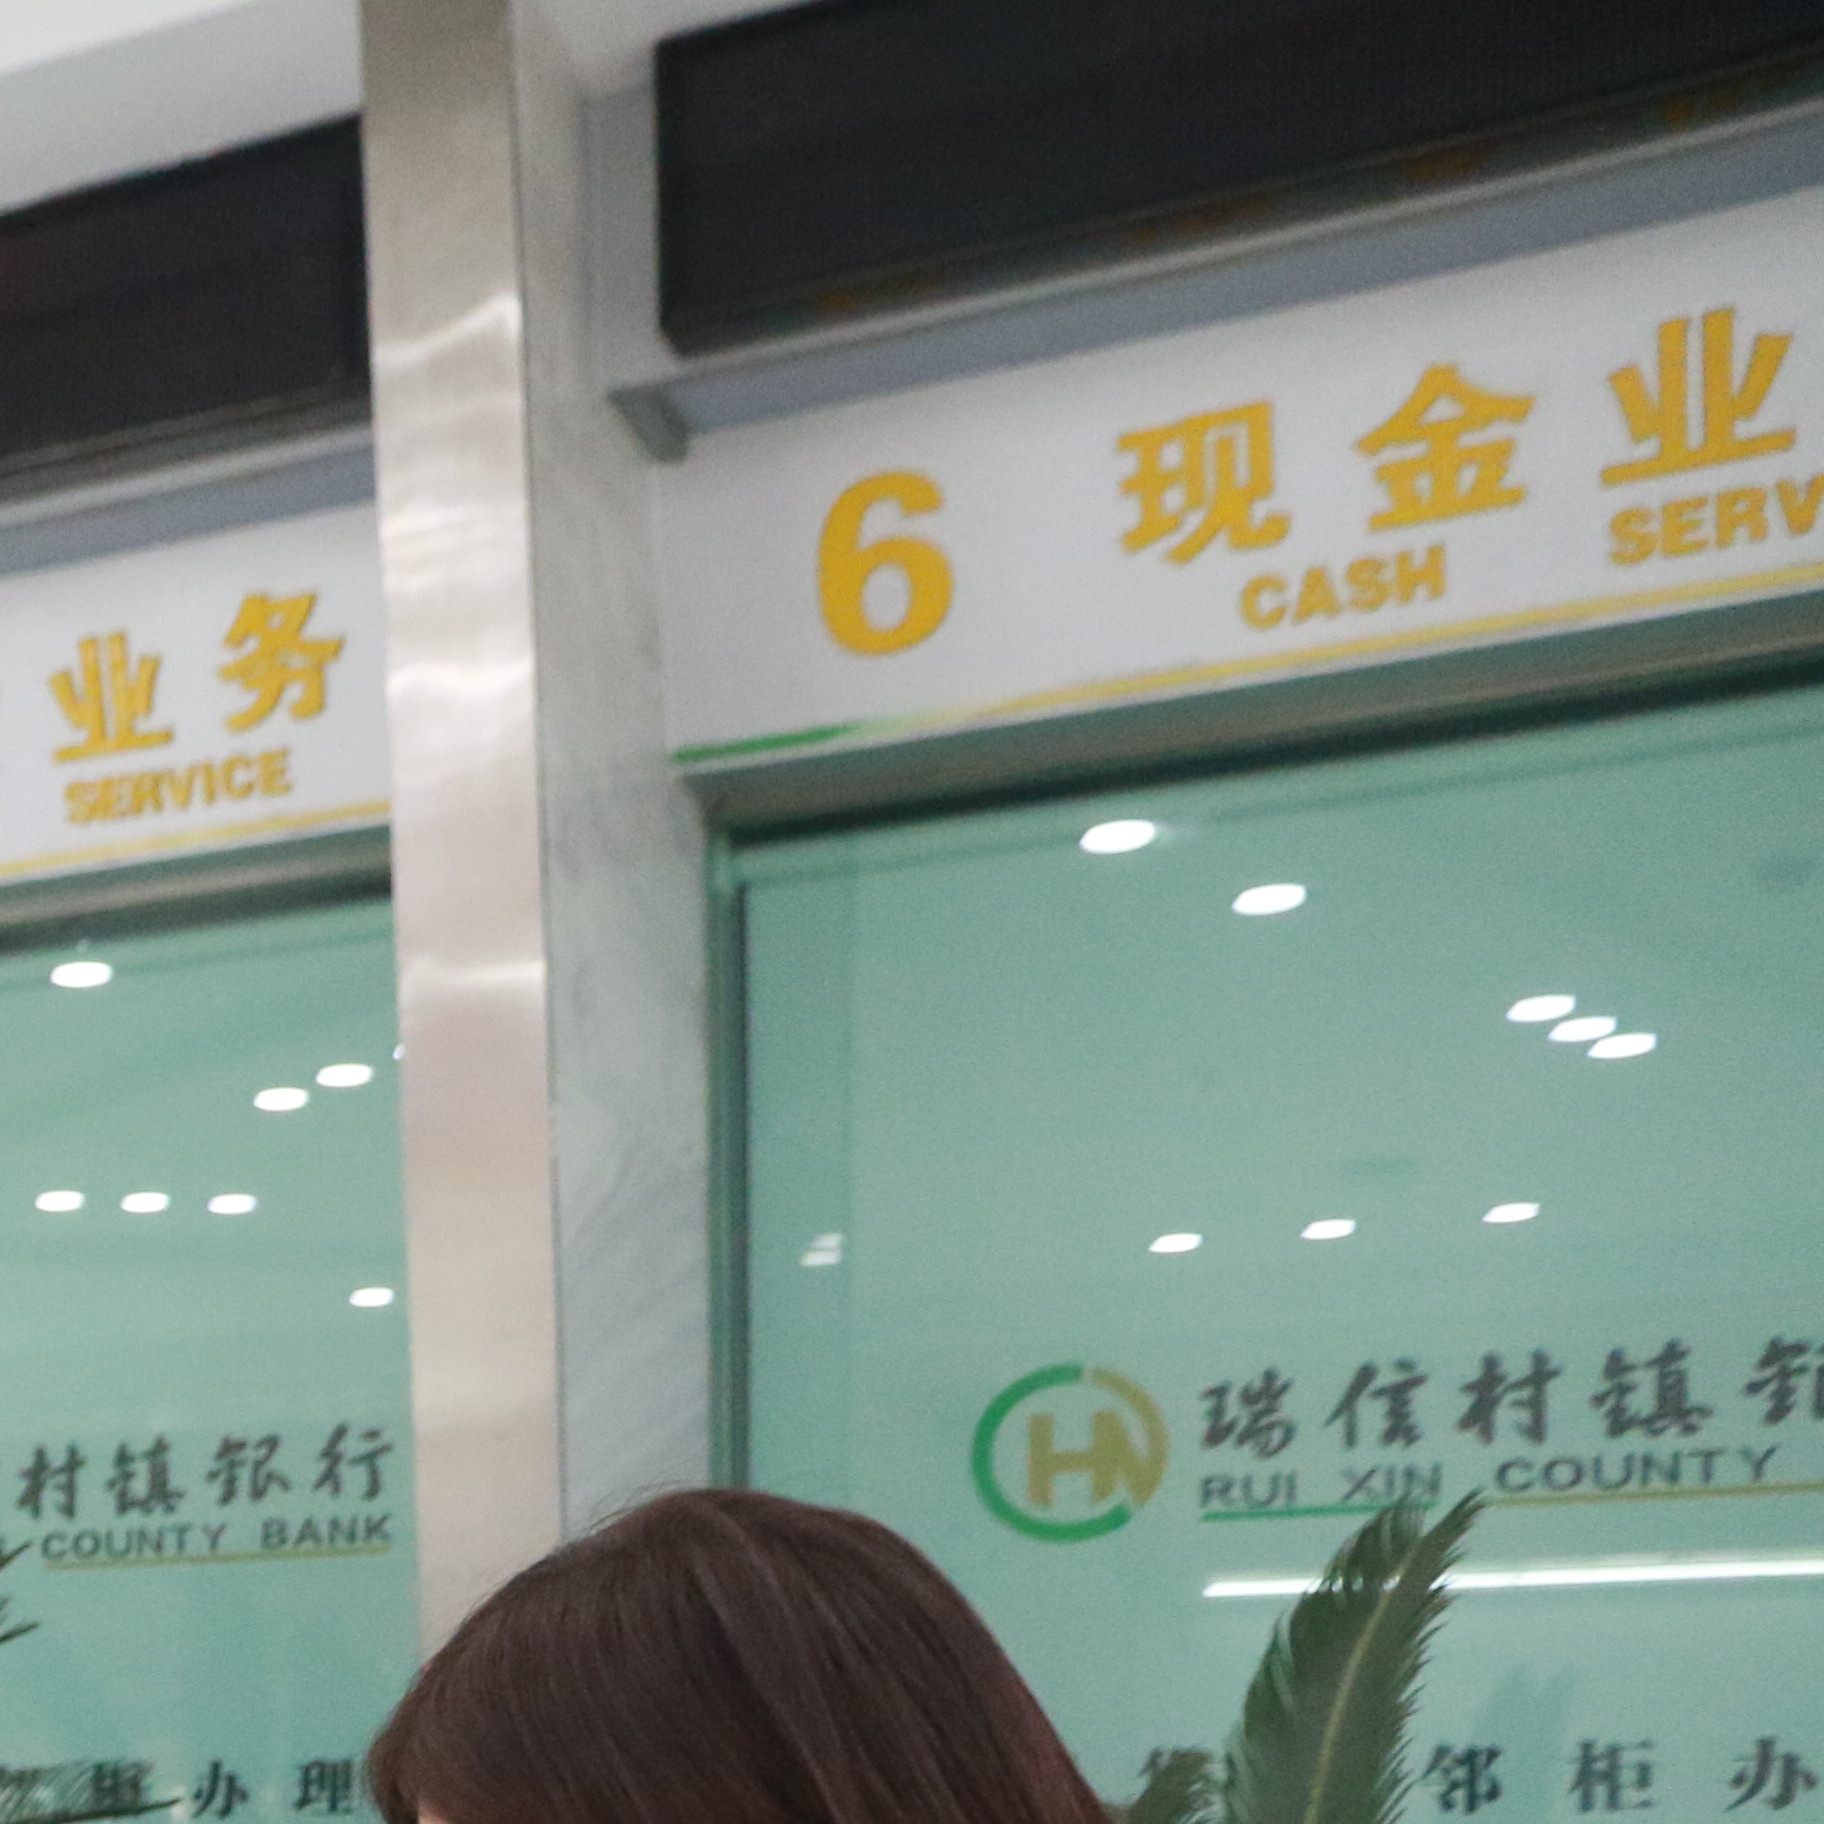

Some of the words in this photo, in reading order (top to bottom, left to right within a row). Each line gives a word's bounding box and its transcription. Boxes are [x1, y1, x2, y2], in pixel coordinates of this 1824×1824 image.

[818, 471, 954, 658] 6
[1116, 306, 1797, 566] 现金业
[1239, 543, 1449, 631] CASH
[64, 747, 293, 826] SERVICE
[1200, 1470, 1297, 1509] RUI
[1340, 1461, 1442, 1503] XIN
[1494, 1444, 1779, 1494] COUNTY
[41, 1523, 229, 1562] COUNTY
[261, 1513, 393, 1551] BANK
